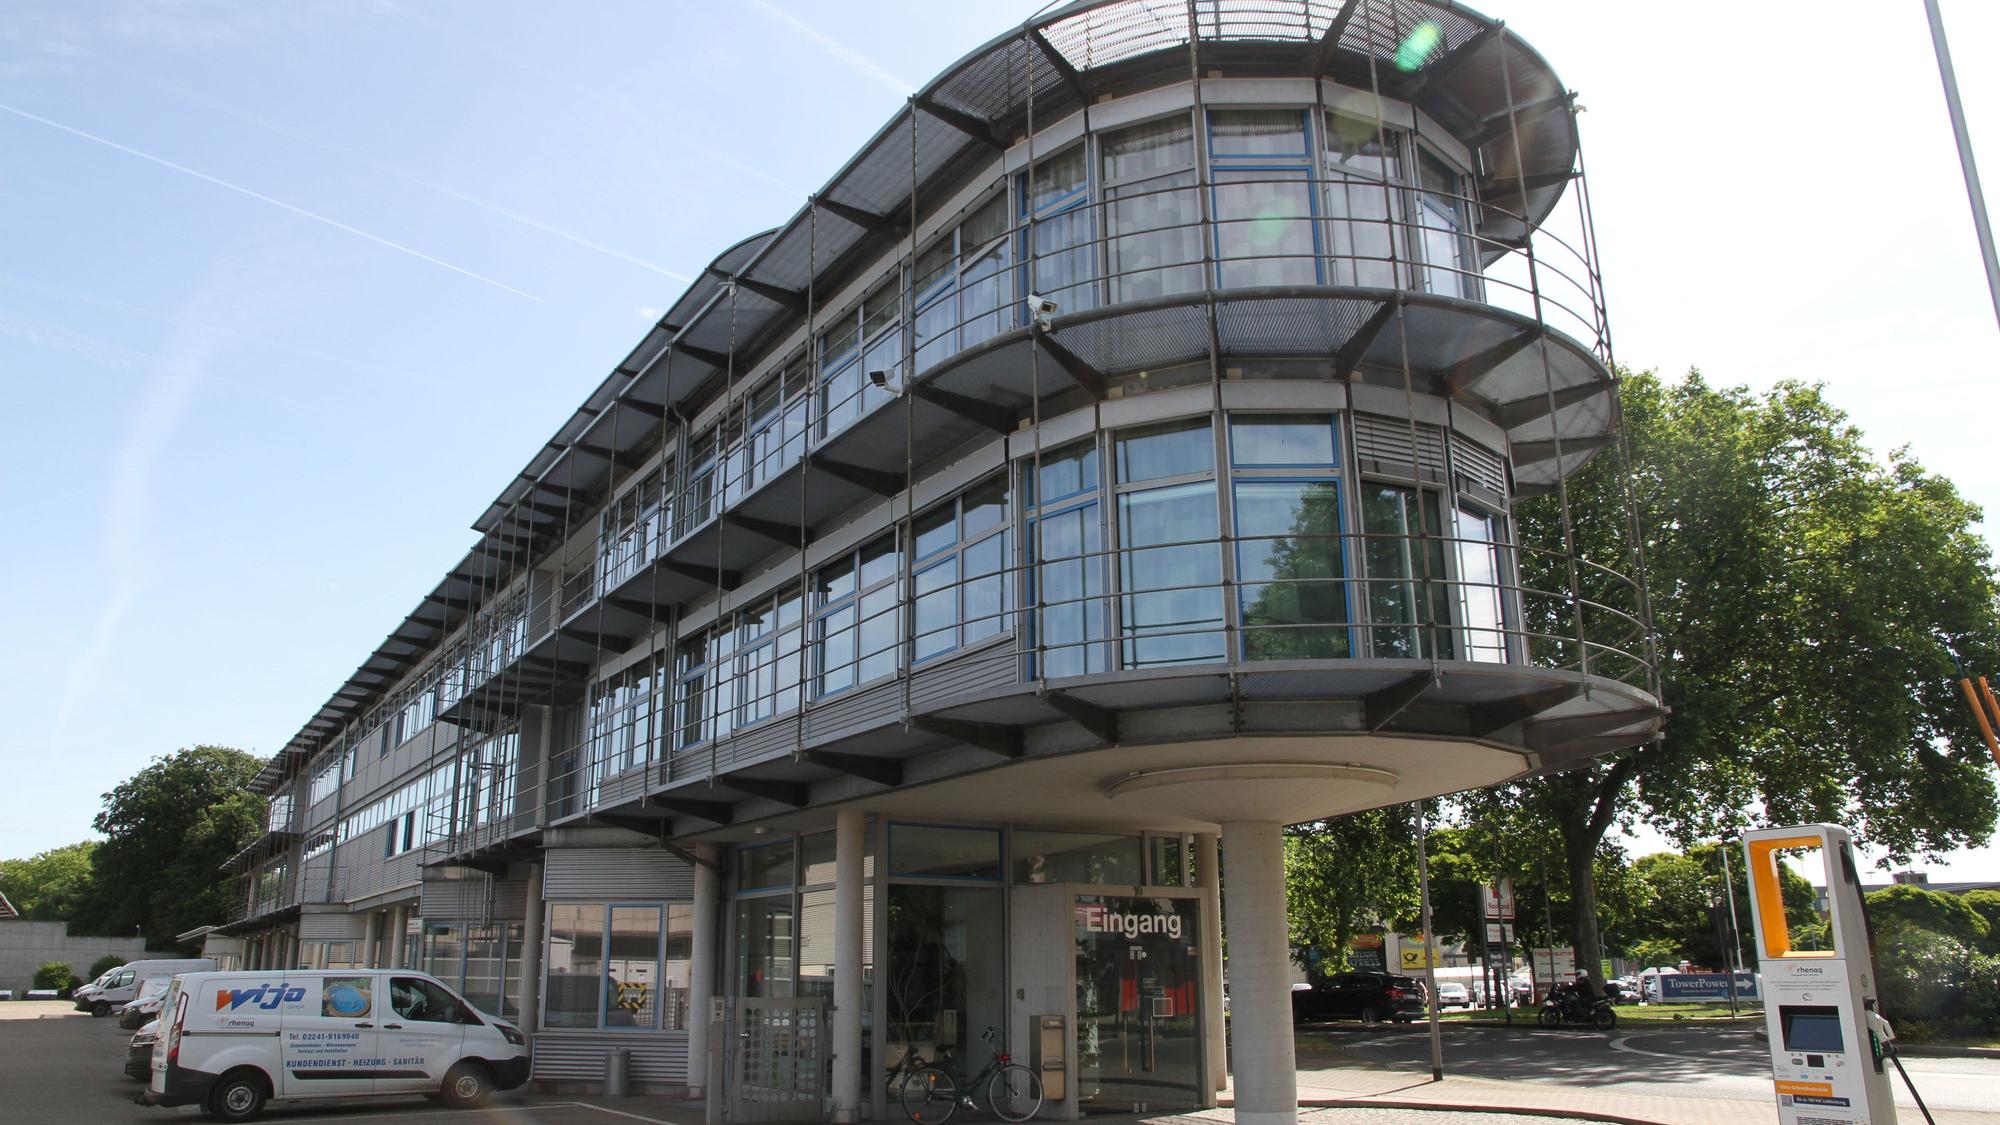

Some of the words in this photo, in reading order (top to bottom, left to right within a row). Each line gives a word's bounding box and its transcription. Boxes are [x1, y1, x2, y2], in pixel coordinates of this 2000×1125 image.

[1086, 907, 1182, 939] Eingang
[286, 1059, 346, 1068] KUNDENDIENST
[353, 1058, 386, 1066] HEIZUNG
[393, 1056, 425, 1065] SANITÄR
